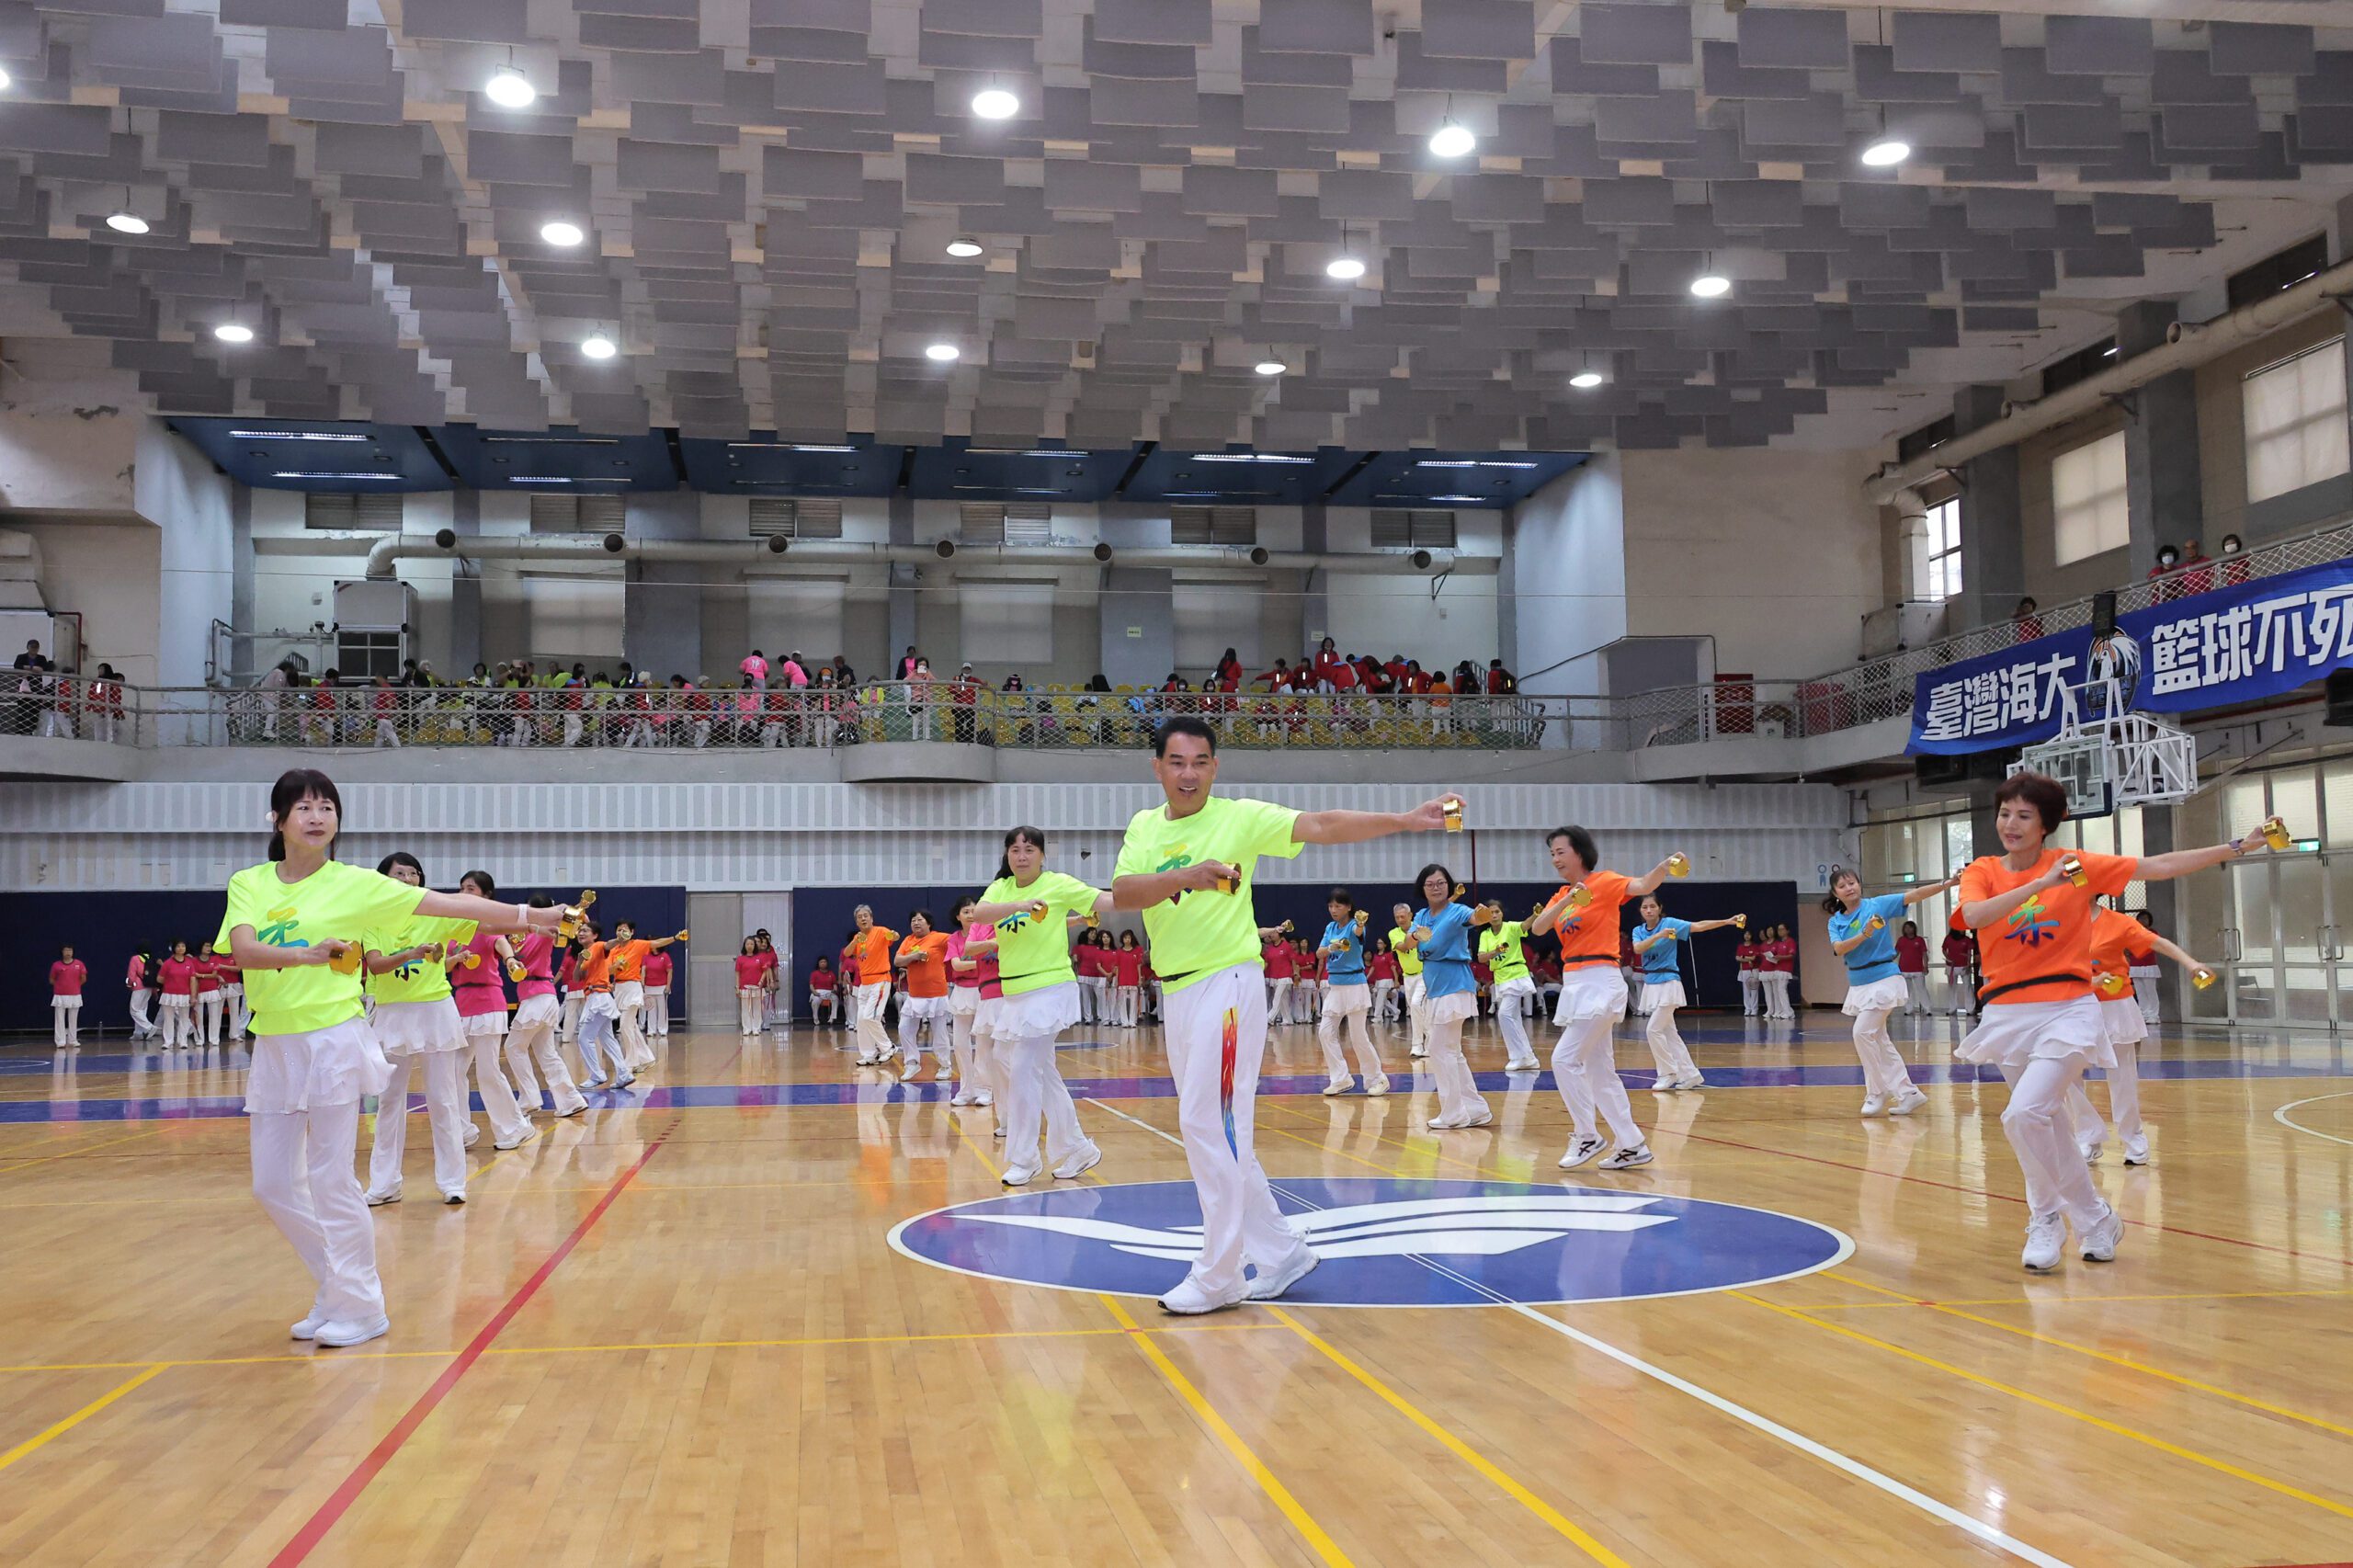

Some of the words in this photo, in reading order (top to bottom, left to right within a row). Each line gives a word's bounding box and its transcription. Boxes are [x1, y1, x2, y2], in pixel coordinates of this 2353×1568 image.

[1919, 652, 2076, 741] 臺灣海大
[2004, 893, 2061, 948] 柔
